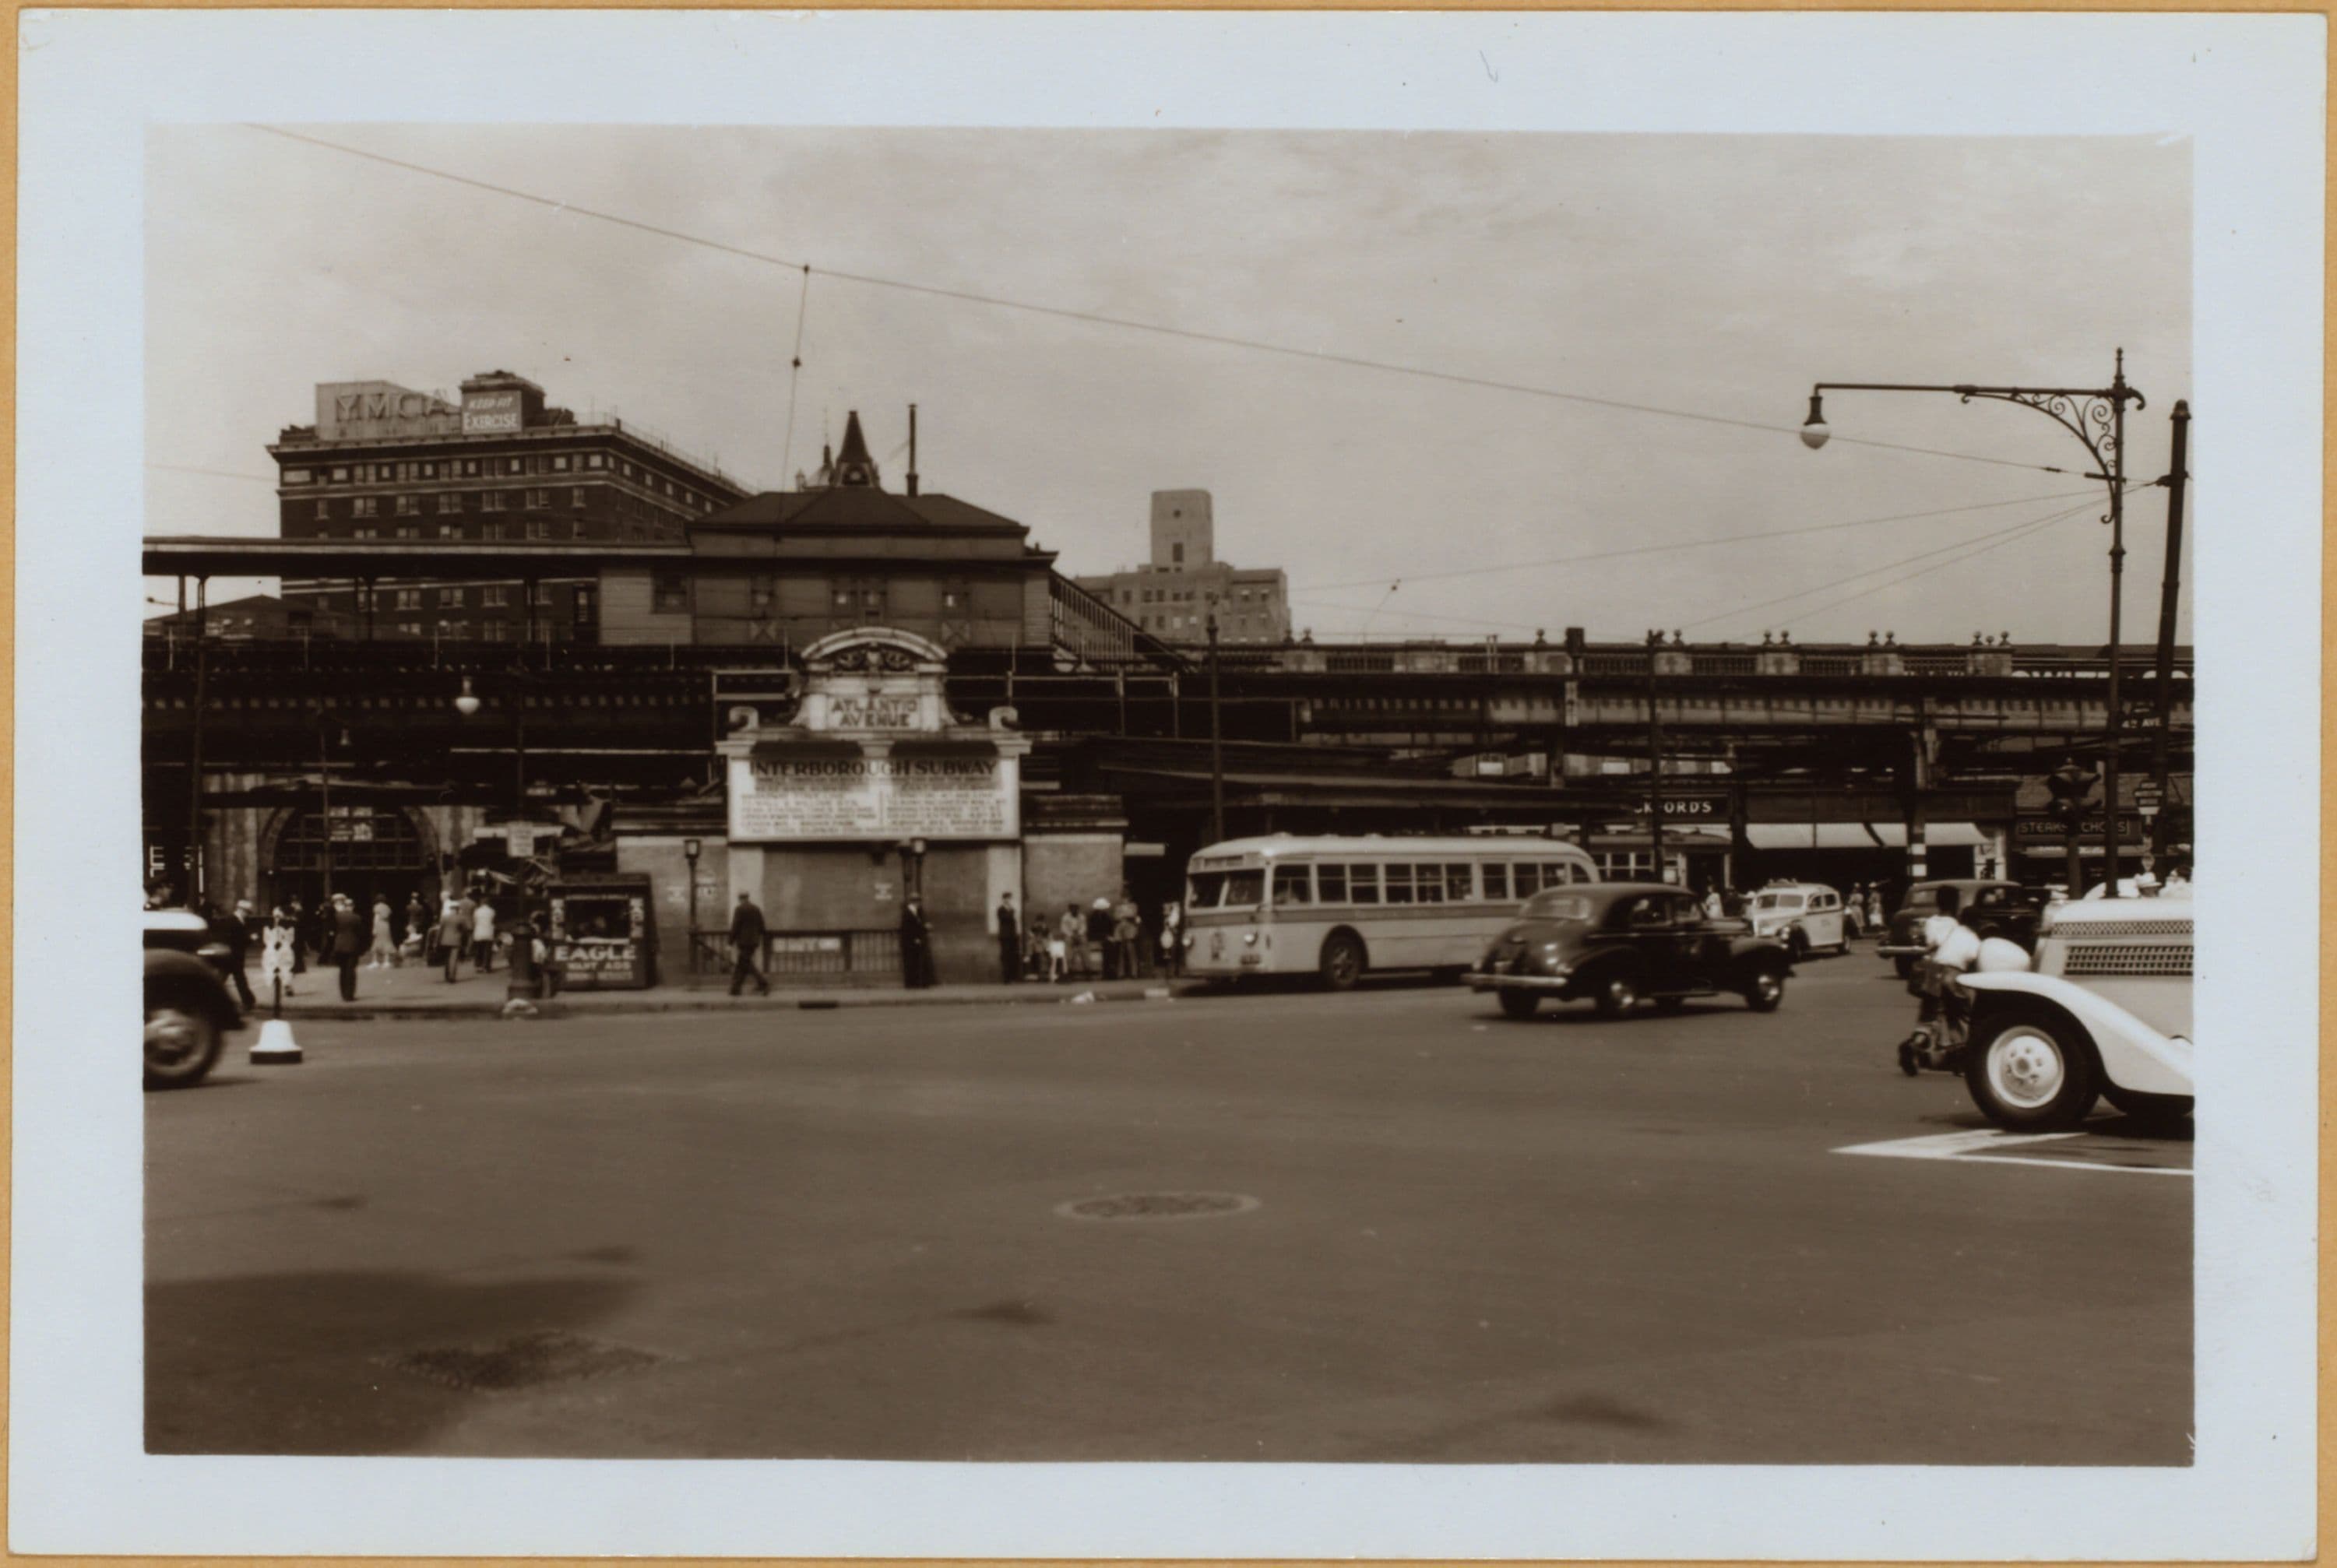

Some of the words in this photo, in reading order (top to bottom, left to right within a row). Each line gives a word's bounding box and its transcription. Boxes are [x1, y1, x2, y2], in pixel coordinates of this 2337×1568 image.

[832, 698, 919, 713] ATLANTIC
[839, 712, 910, 727] AVENUE
[750, 761, 910, 776] INTERBOROUGH
[915, 760, 998, 776] SUBWAY
[554, 945, 636, 962] EAGLE
